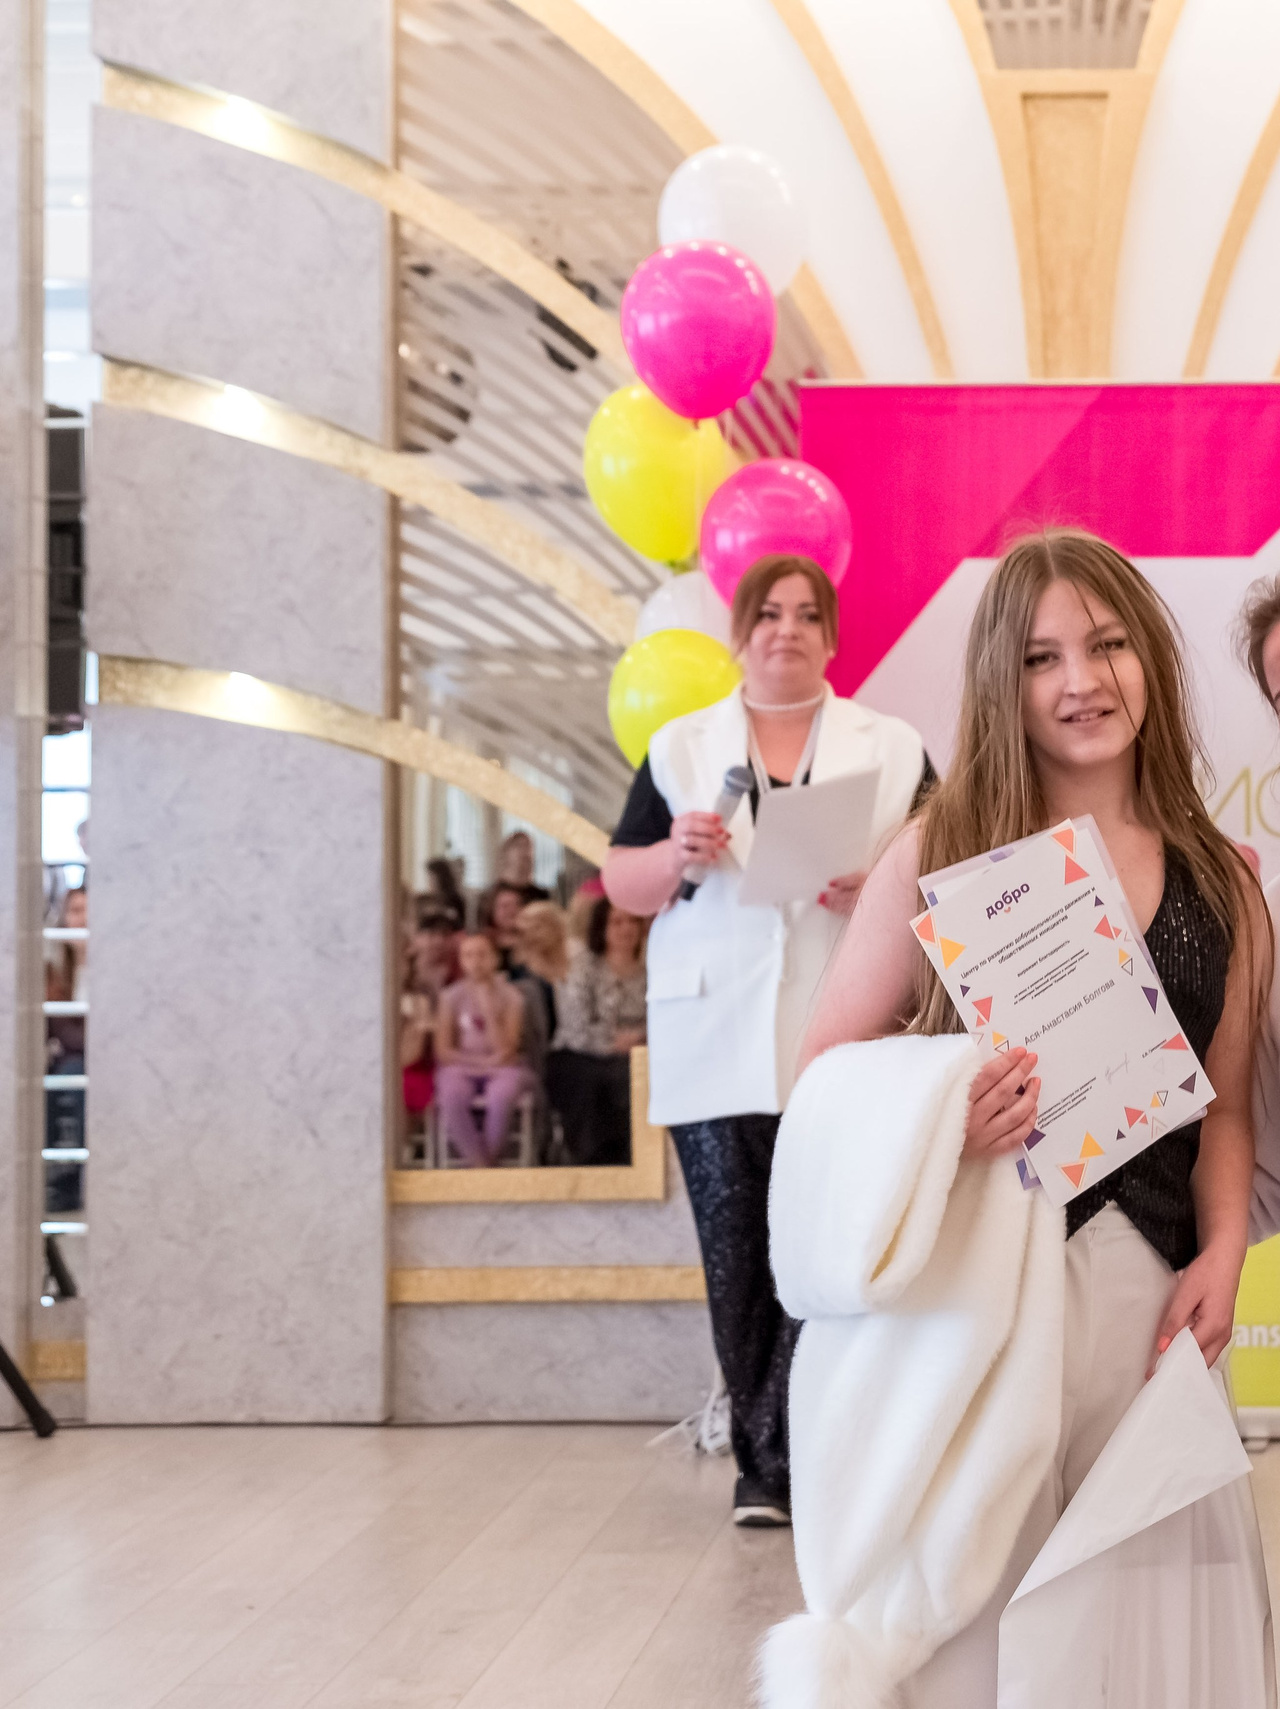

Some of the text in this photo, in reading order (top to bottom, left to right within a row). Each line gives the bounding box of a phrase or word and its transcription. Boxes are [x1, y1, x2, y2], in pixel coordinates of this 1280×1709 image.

[985, 882, 1030, 920] добро
[959, 964, 980, 980] Центр
[978, 958, 988, 968] по
[986, 940, 1015, 963] развитию
[1013, 907, 1064, 945] добровольческого
[1063, 888, 1091, 912] движения
[997, 914, 1069, 965] общественных инициатив
[1023, 978, 1116, 1047] Ася-Анастасия Болгова
